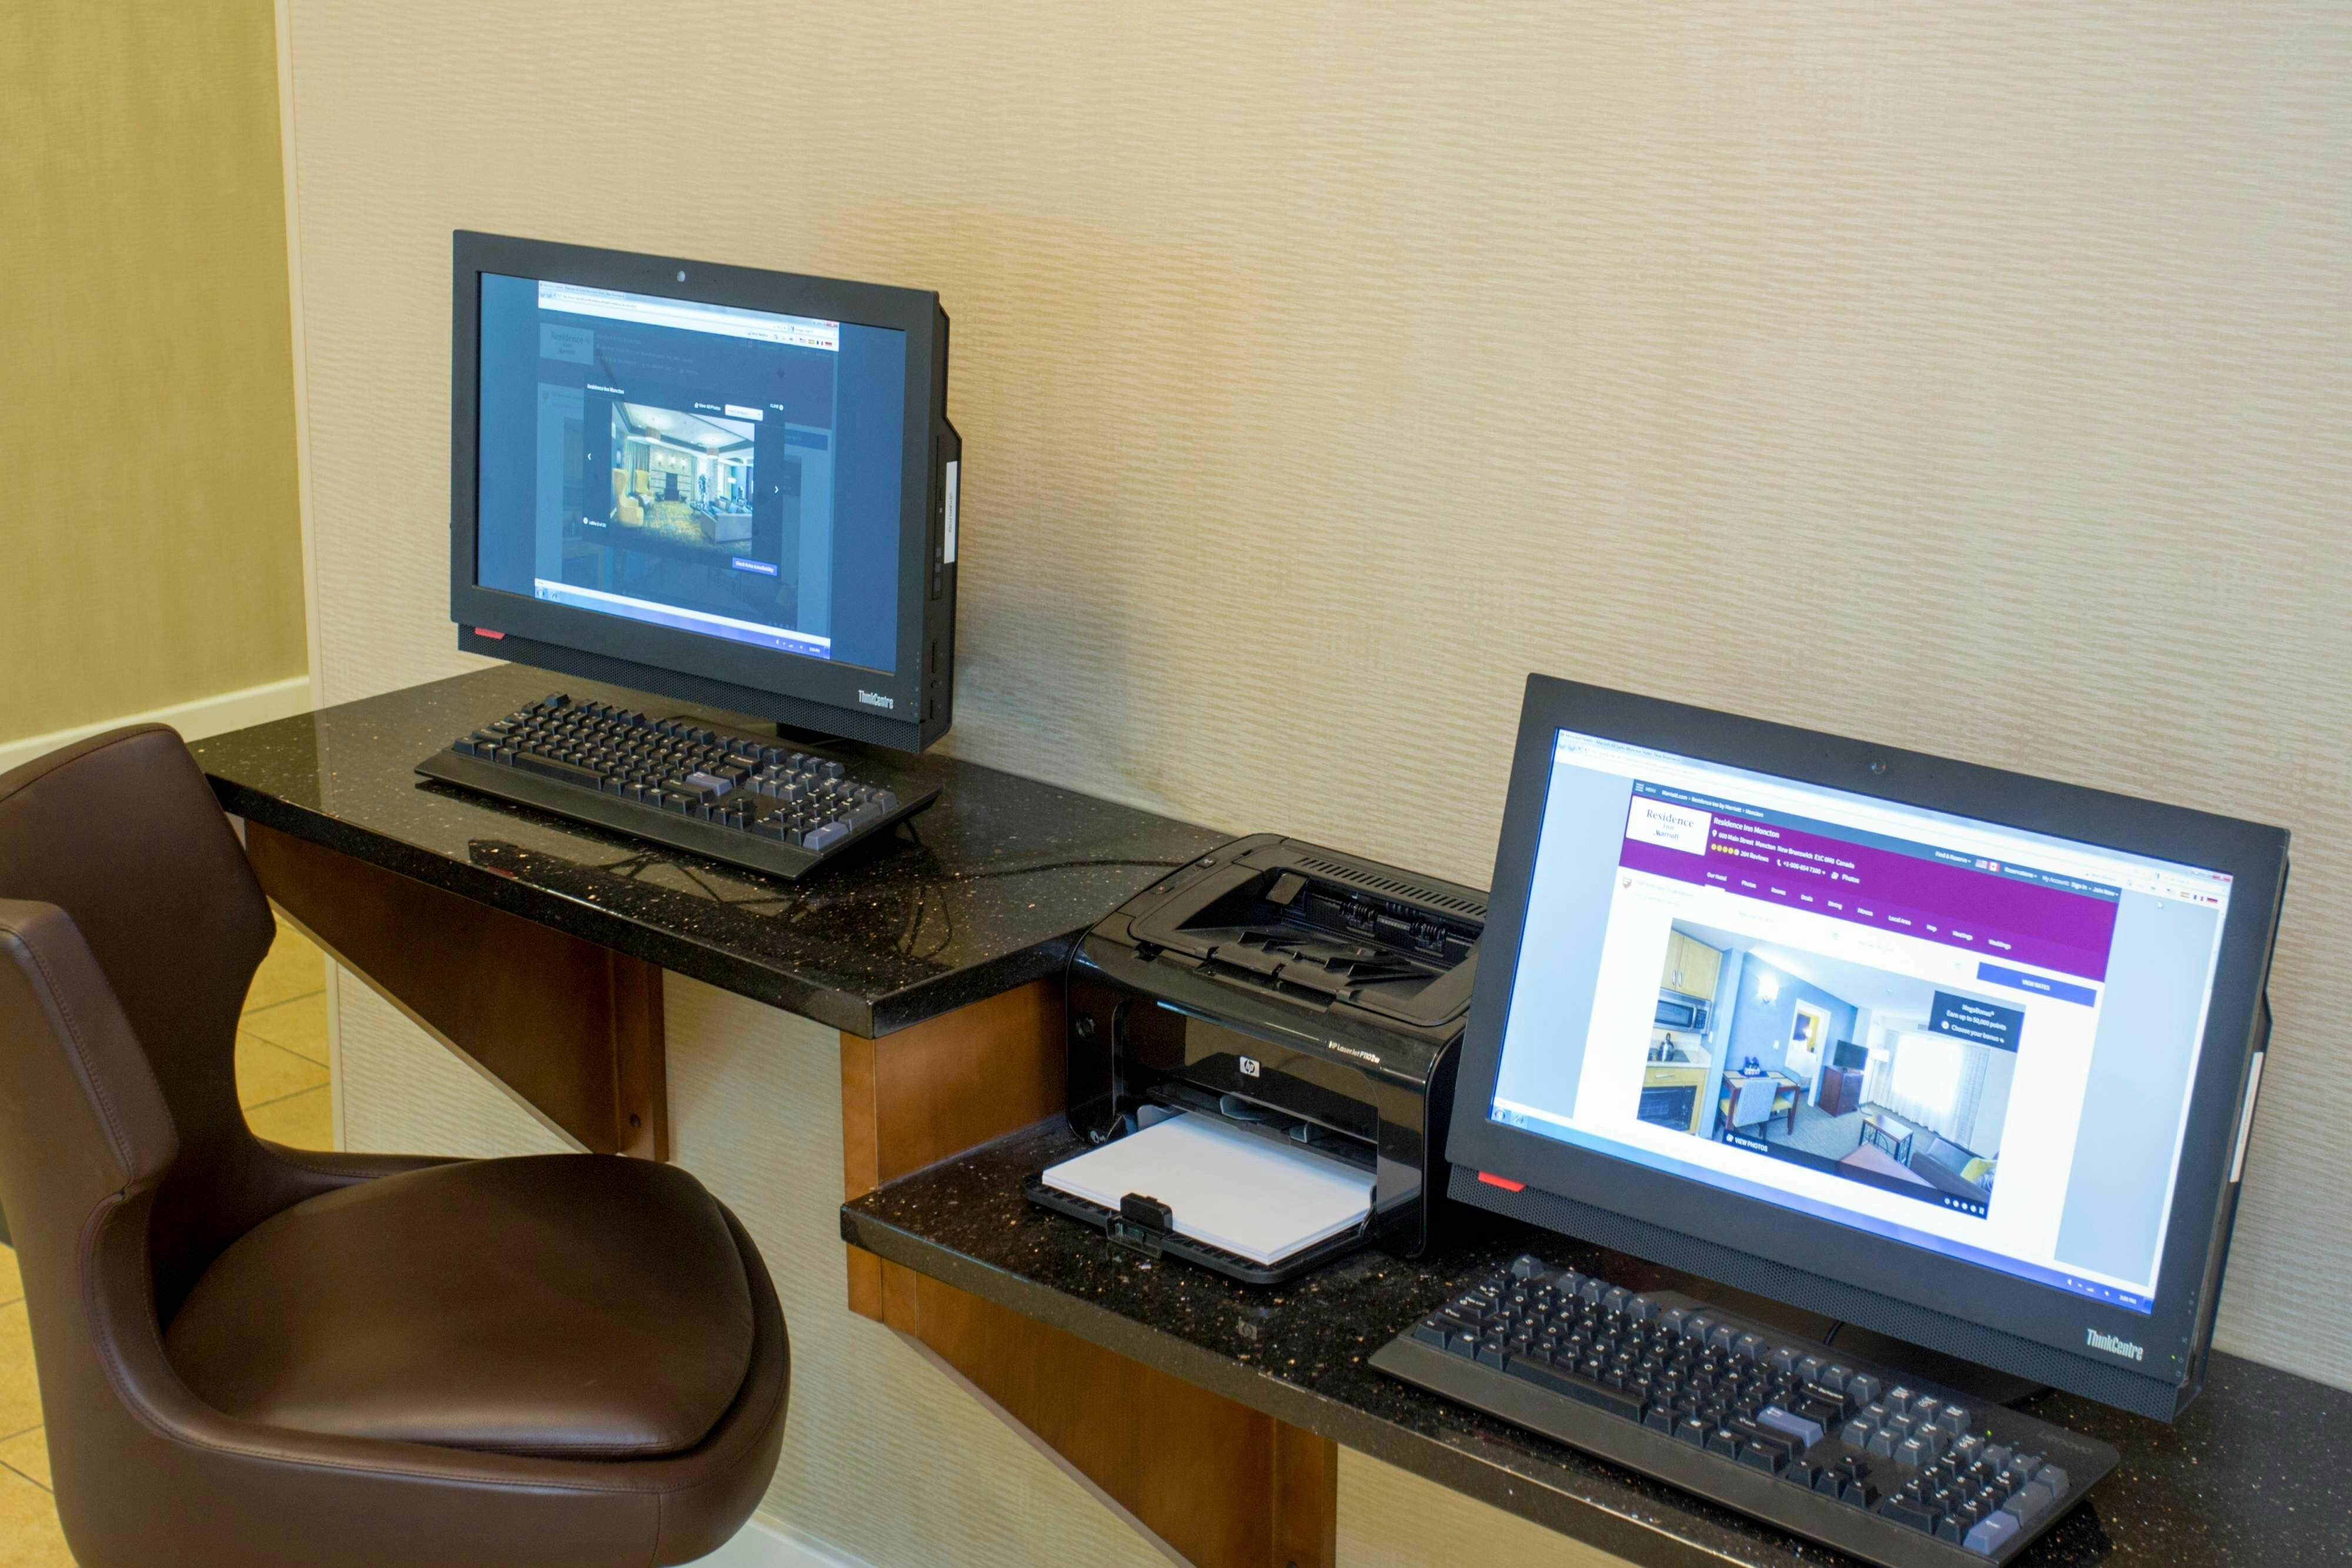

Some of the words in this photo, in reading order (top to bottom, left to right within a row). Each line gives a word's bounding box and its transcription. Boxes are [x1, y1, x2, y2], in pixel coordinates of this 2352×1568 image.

[858, 690, 894, 709] ThinkCentre
[1662, 790, 1688, 801] Marriott.com
[1691, 797, 1712, 806] Residence
[1745, 809, 1764, 818] Moncton
[1646, 809, 1694, 828] Residence
[1713, 817, 1743, 831] Residence
[1743, 824, 1753, 833] Inn
[1753, 826, 1780, 839] Moncton
[1728, 834, 1739, 842] Main
[1777, 845, 1788, 854] New
[1836, 859, 1855, 869] Canada
[1749, 852, 1769, 862] Reviews
[1741, 880, 1757, 889] Photos
[1842, 872, 1860, 884] Photos
[2022, 978, 2034, 988] VIEW
[2034, 982, 2050, 991] RATES
[1946, 1009, 1959, 1019] Earn
[1959, 1014, 1966, 1022] up
[1989, 1021, 2007, 1031] points
[1951, 1024, 1970, 1035] Choose
[1970, 1029, 1983, 1038] your
[1983, 1032, 1999, 1042] bonus
[1328, 1040, 1338, 1050] HP
[1337, 1044, 1360, 1057] LaserJet
[1244, 1059, 1255, 1075] hp
[1735, 1136, 1748, 1146] VIEW
[1747, 1140, 1769, 1152] PHOTOS
[2087, 1328, 2144, 1362] ThinkCentre
